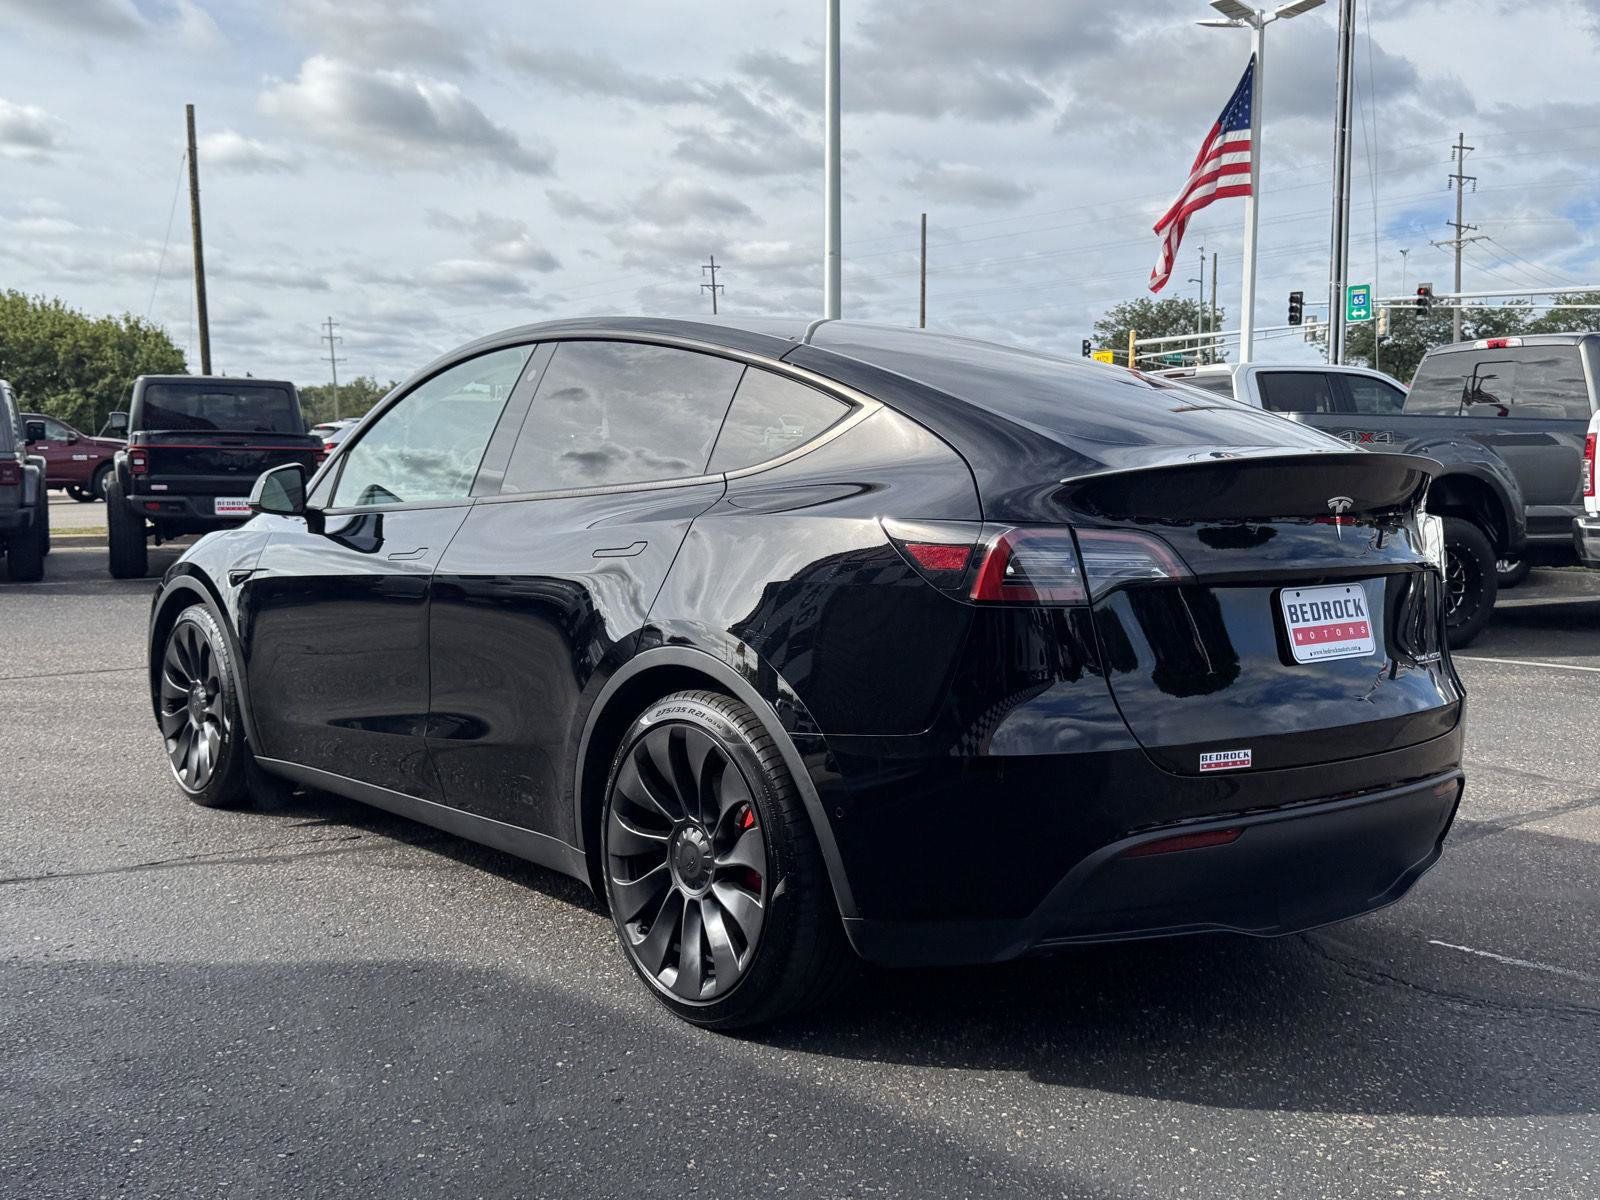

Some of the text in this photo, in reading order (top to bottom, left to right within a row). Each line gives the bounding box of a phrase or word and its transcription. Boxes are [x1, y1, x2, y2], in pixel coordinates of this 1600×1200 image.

[1353, 295, 1365, 305] 65
[1287, 598, 1365, 624] BEDROCK
[1296, 626, 1366, 641] MOTORS
[655, 706, 688, 717] 275/35
[688, 708, 706, 718] R21
[1201, 751, 1250, 762] BEDROCK
